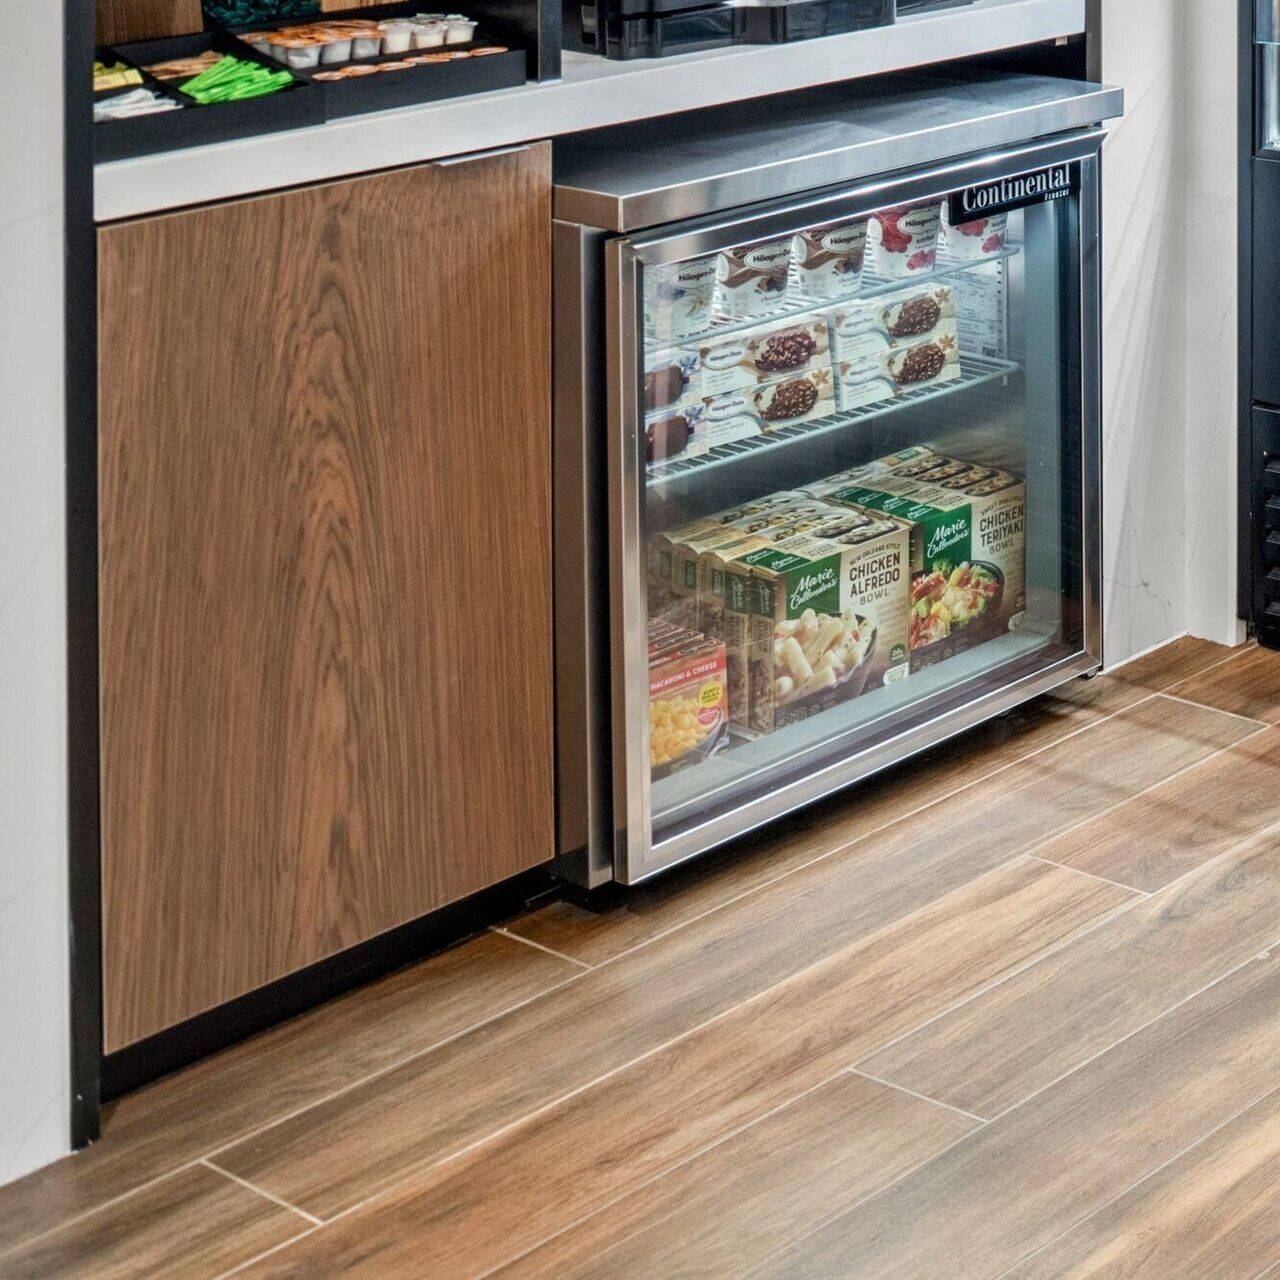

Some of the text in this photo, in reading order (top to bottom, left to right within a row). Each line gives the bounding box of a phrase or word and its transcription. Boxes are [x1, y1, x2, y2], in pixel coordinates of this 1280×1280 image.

[962, 162, 1070, 212] Continental
[1045, 188, 1070, 201] Freezer
[905, 212, 939, 228] Häagen-D
[830, 231, 868, 246] Häagen-D
[753, 249, 792, 264] Häagen-D
[678, 268, 717, 283] Häagen-D
[980, 504, 1024, 531] CHICKEN
[927, 519, 967, 547] Marie
[927, 529, 969, 558] Callender's
[981, 520, 1024, 547] TERIYAKI
[850, 555, 862, 566] NEW
[862, 546, 885, 557] ORLEANS
[989, 540, 1015, 555] BOWL
[850, 552, 900, 581] CHICKEN
[790, 577, 838, 610] Callender's
[791, 568, 834, 598] Marie
[850, 569, 900, 598] ALFREDO
[860, 589, 890, 605] BOWL
[650, 662, 718, 690] MACARONI & CHEESE
